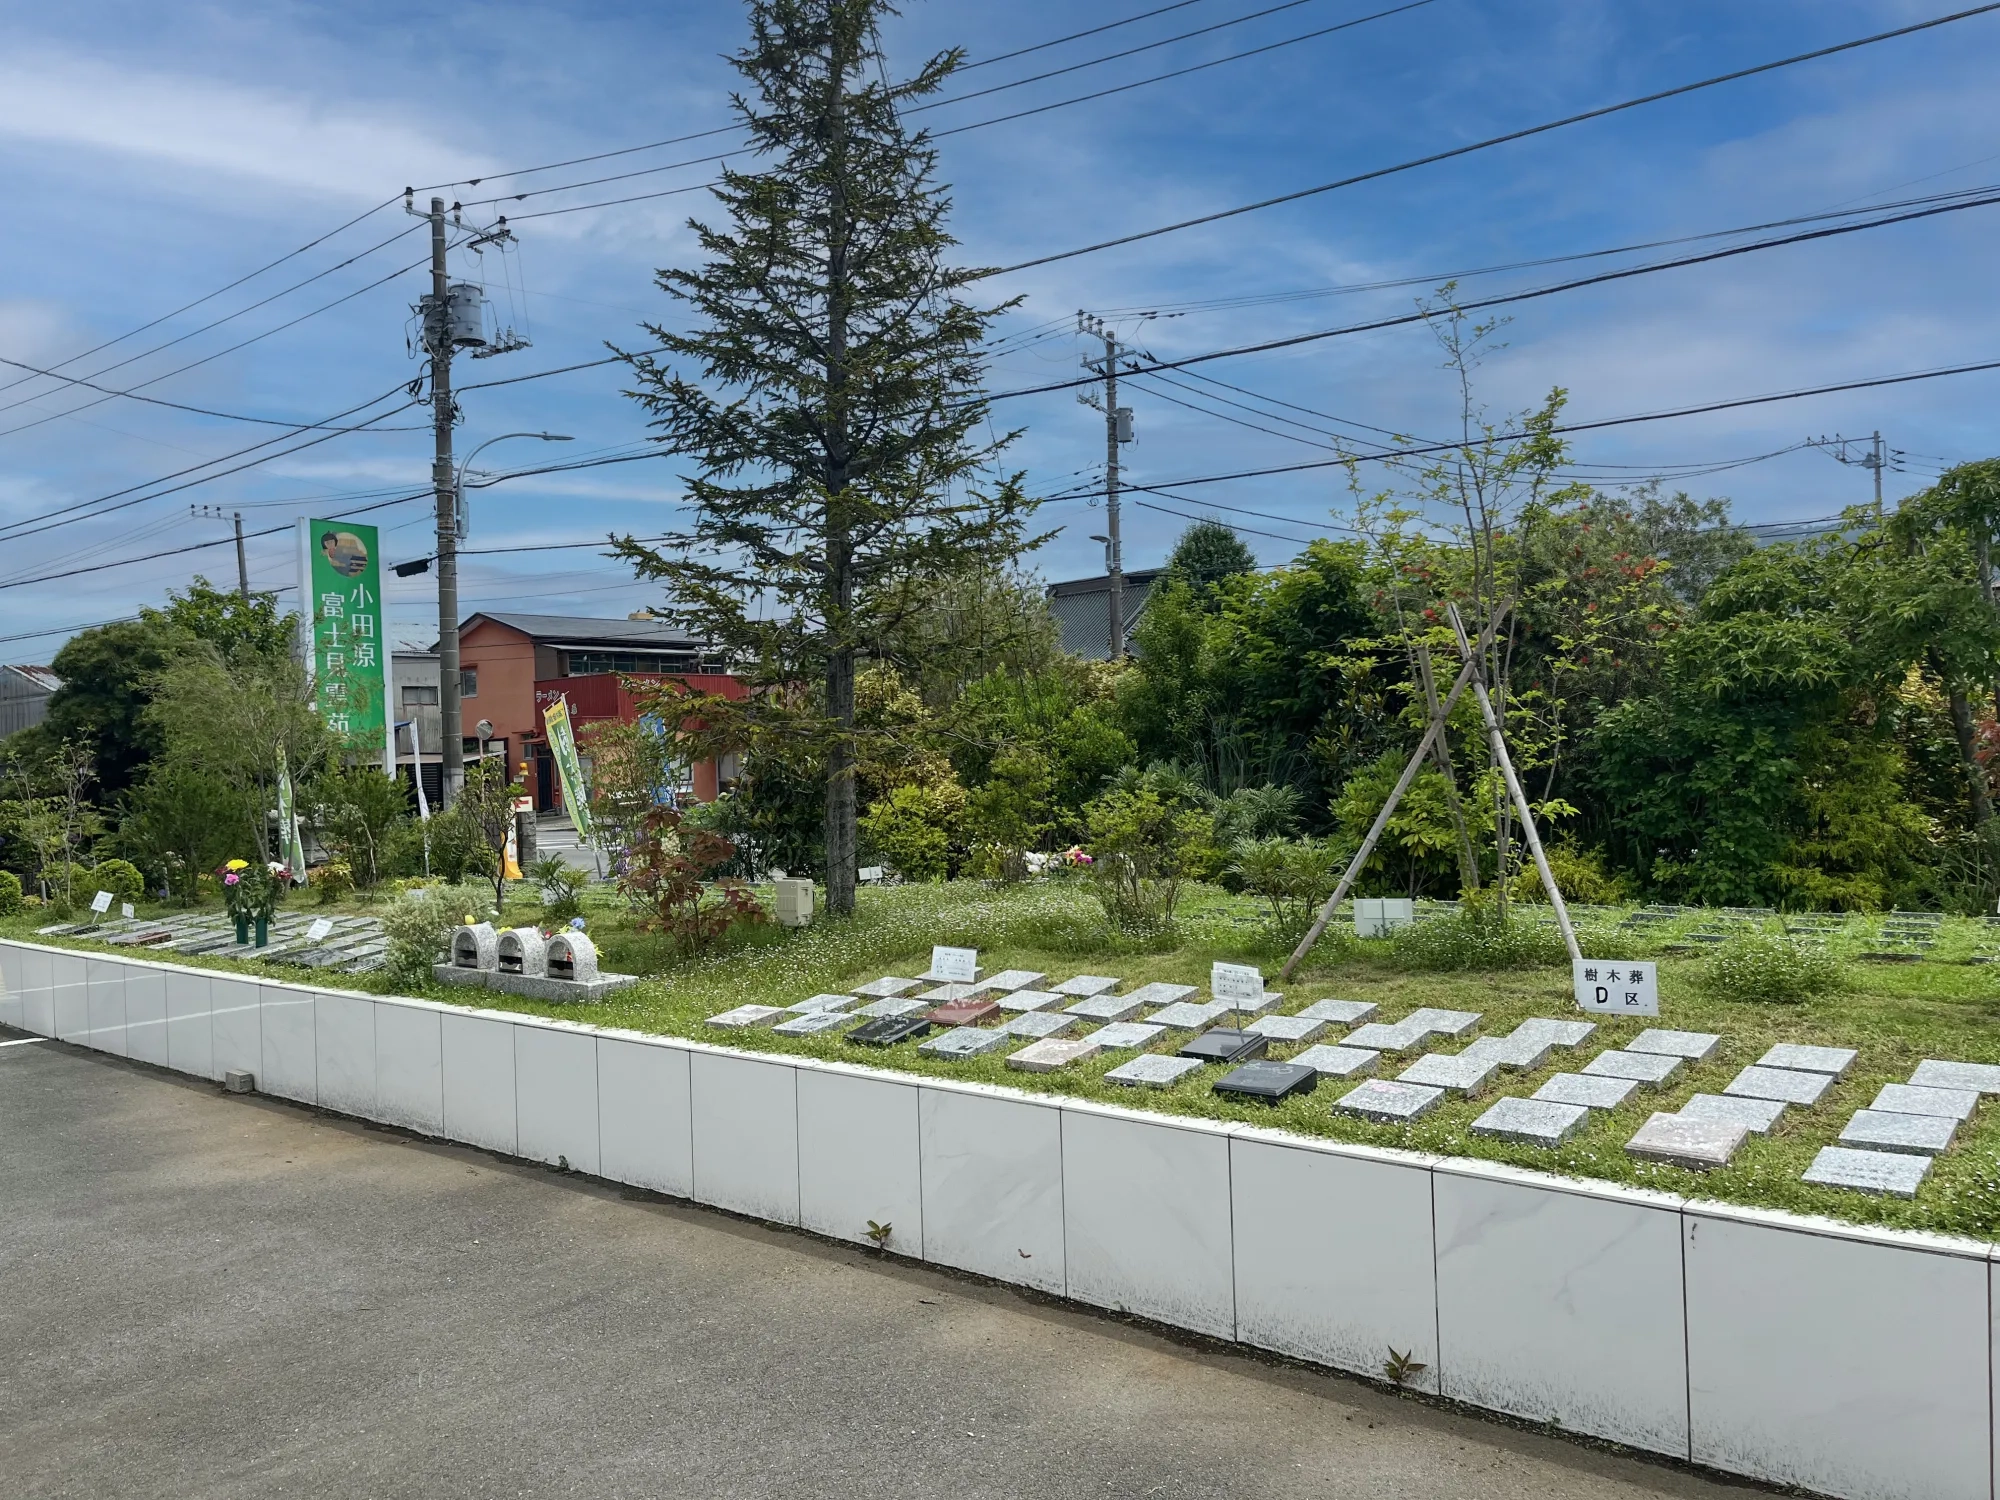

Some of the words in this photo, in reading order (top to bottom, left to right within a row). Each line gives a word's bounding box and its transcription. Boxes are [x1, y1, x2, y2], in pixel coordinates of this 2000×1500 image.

[350, 583, 376, 668] 小田原
[535, 690, 560, 703] ラーメン
[1584, 968, 1643, 984] 樹木葬
